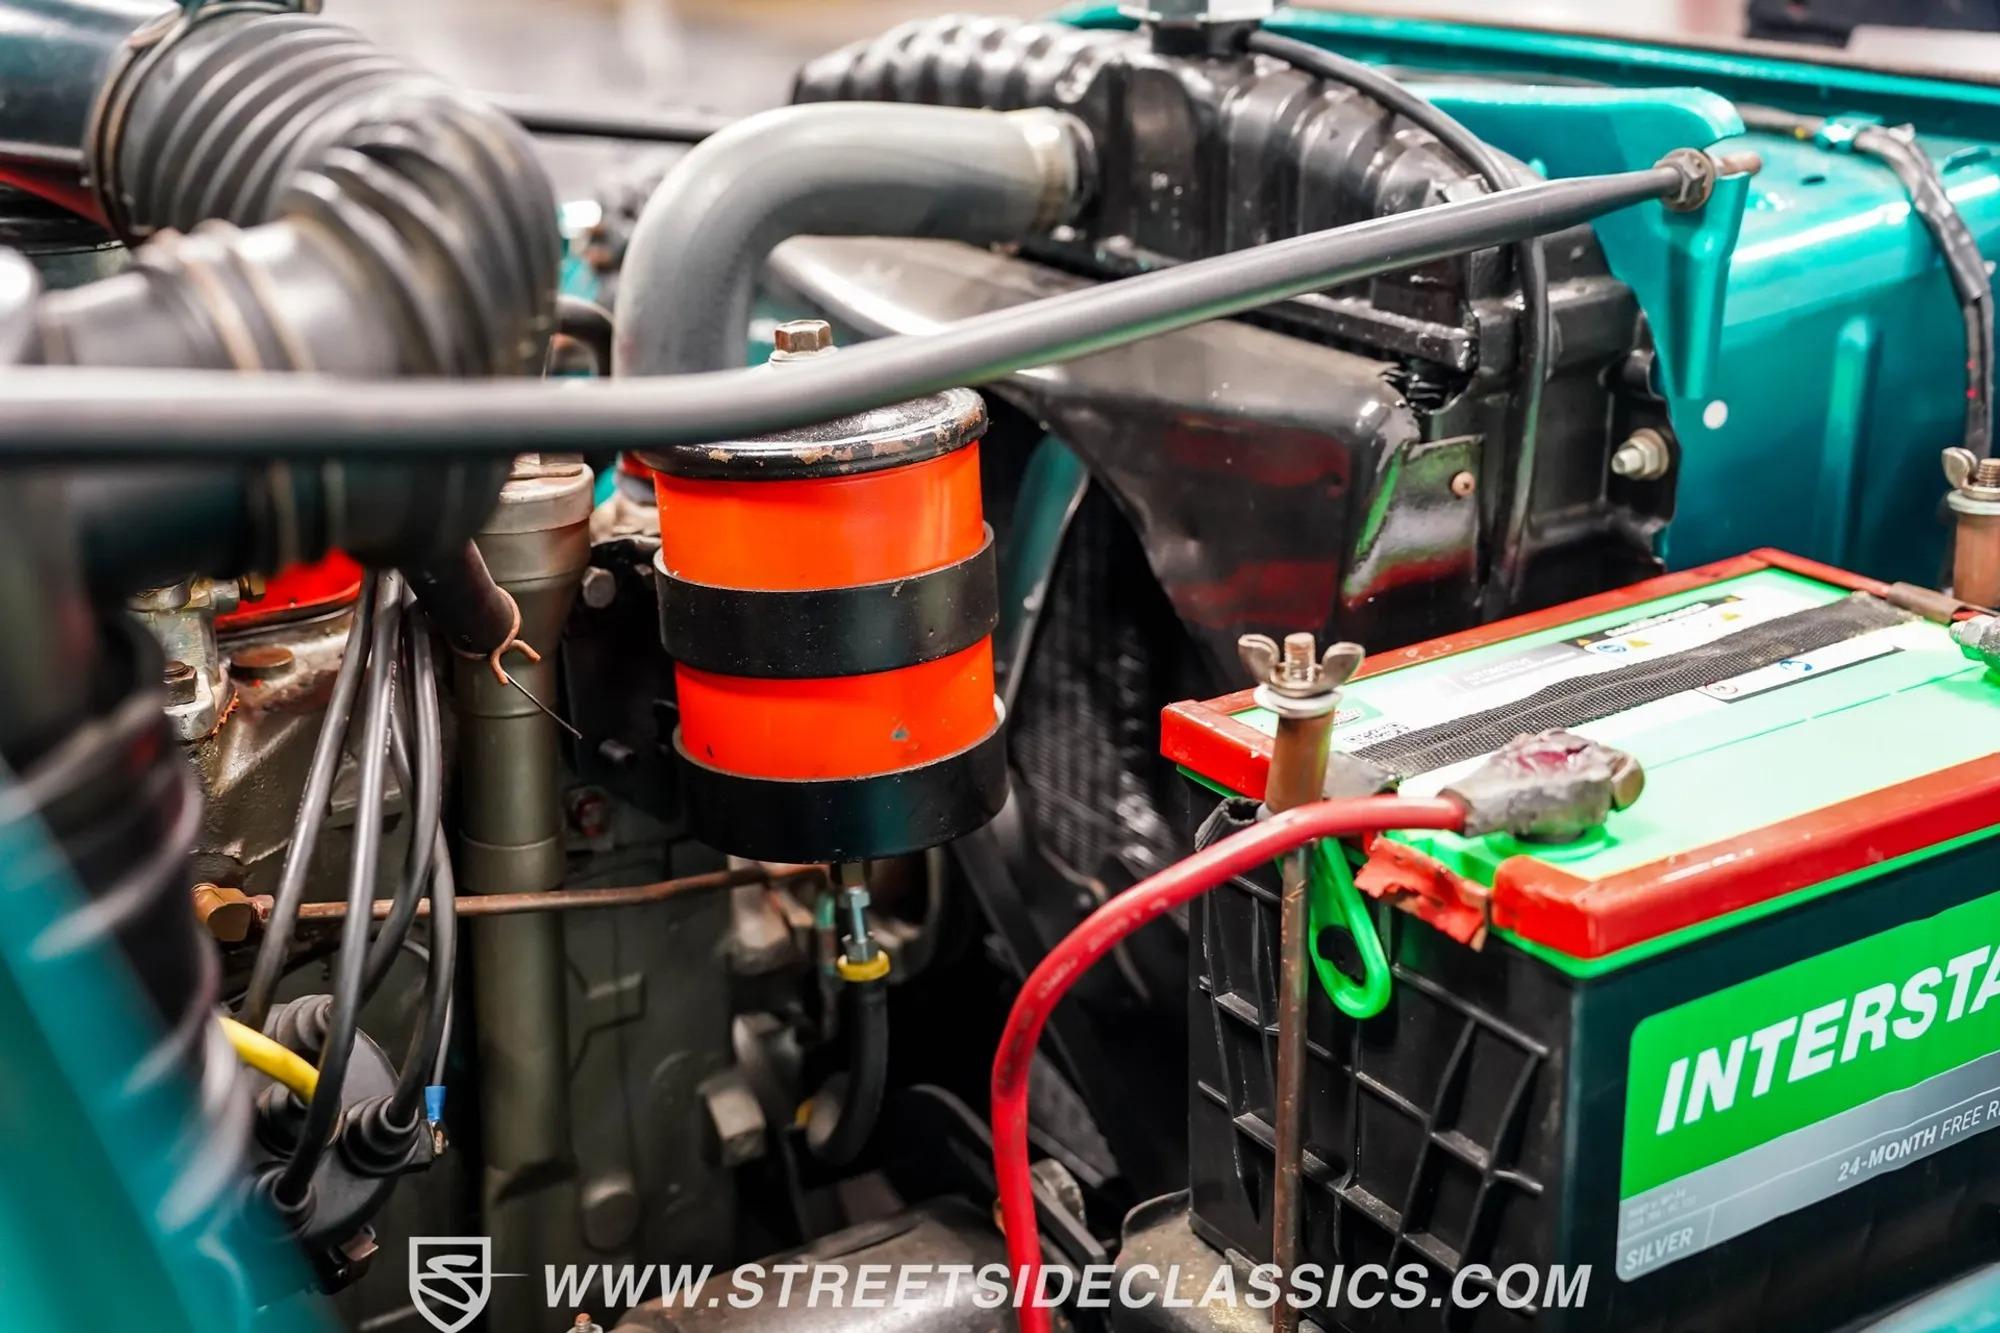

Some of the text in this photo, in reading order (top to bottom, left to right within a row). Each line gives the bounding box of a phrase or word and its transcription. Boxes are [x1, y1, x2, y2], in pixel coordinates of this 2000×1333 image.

[1838, 1125, 1937, 1182] 24-MONTH
[1940, 1105, 1984, 1139] FREE
[1624, 1226, 1694, 1271] SILVER
